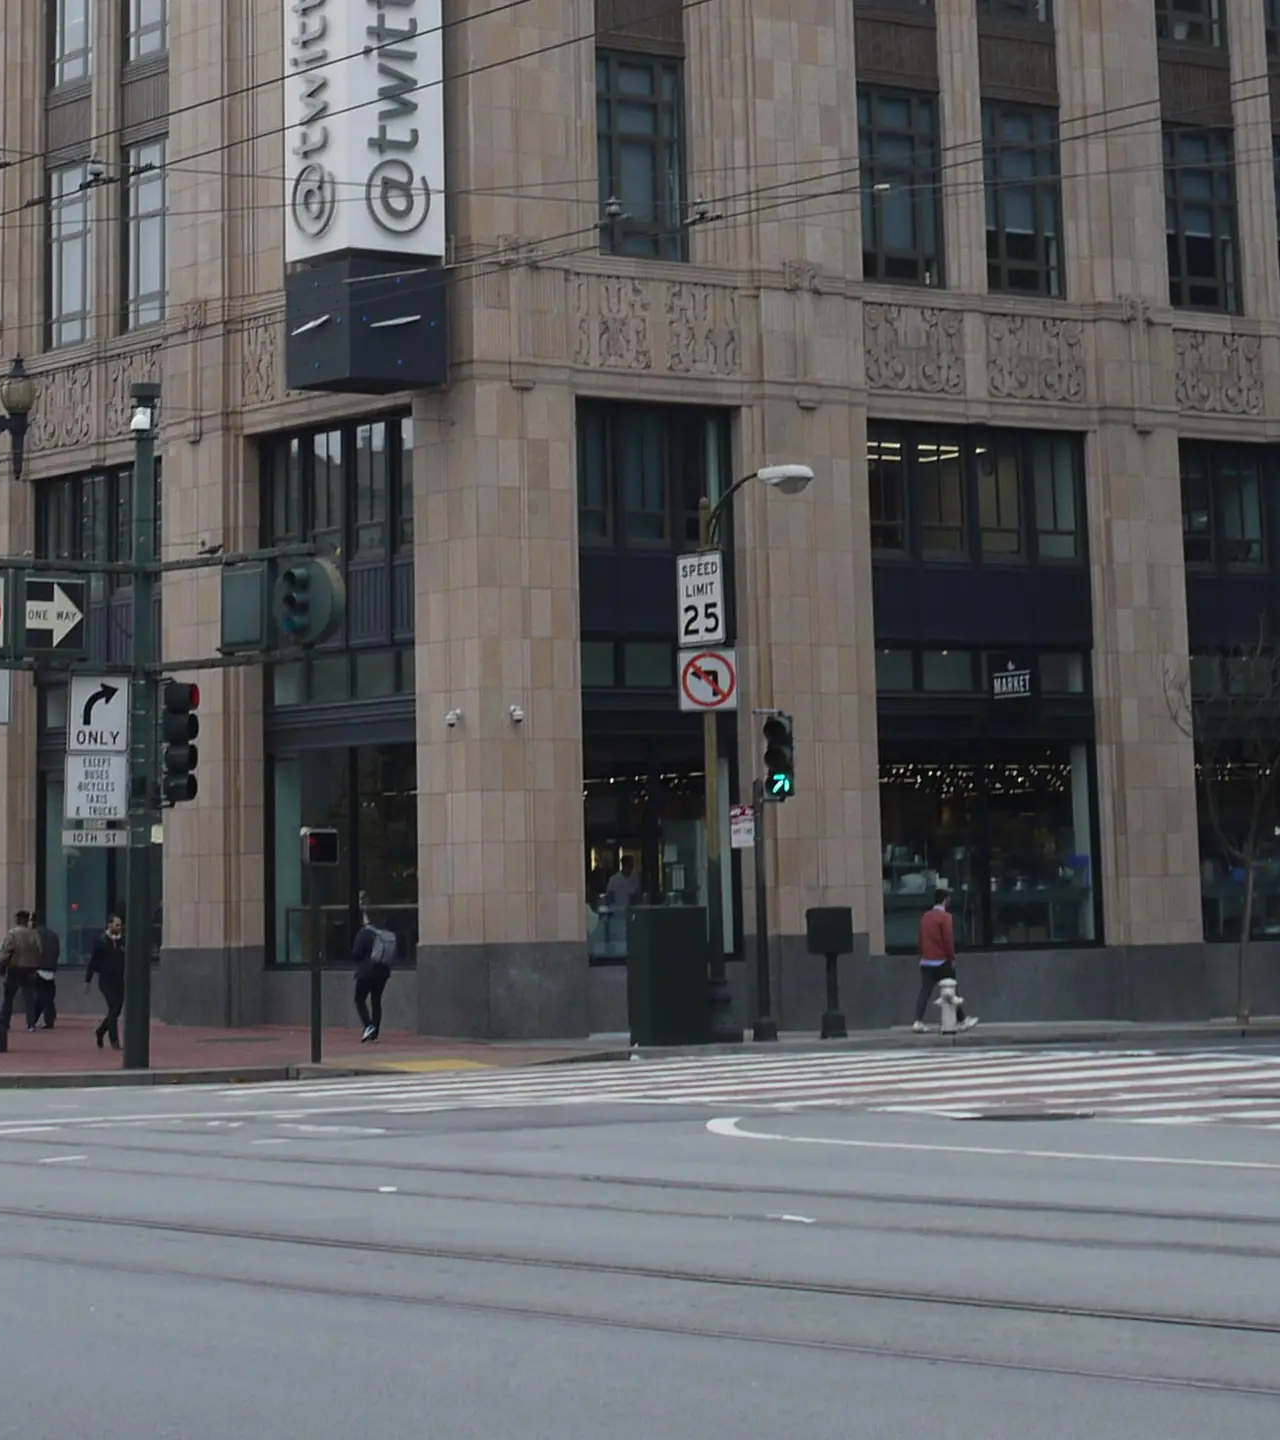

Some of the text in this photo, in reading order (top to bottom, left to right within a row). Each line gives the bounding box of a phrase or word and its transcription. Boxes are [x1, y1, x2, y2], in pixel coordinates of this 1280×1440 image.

[681, 561, 718, 578] SPEED
[685, 581, 715, 598] LIMIT
[28, 610, 77, 622] ONE WAY
[683, 602, 719, 636] 25
[993, 674, 1030, 694] MARKET
[76, 730, 120, 746] ONLY
[83, 757, 111, 768] EXCEPT
[84, 769, 110, 780] BUSES
[77, 781, 115, 792] BICYCLES
[86, 793, 108, 804] TAXIS
[73, 832, 116, 844] 10TH ST
